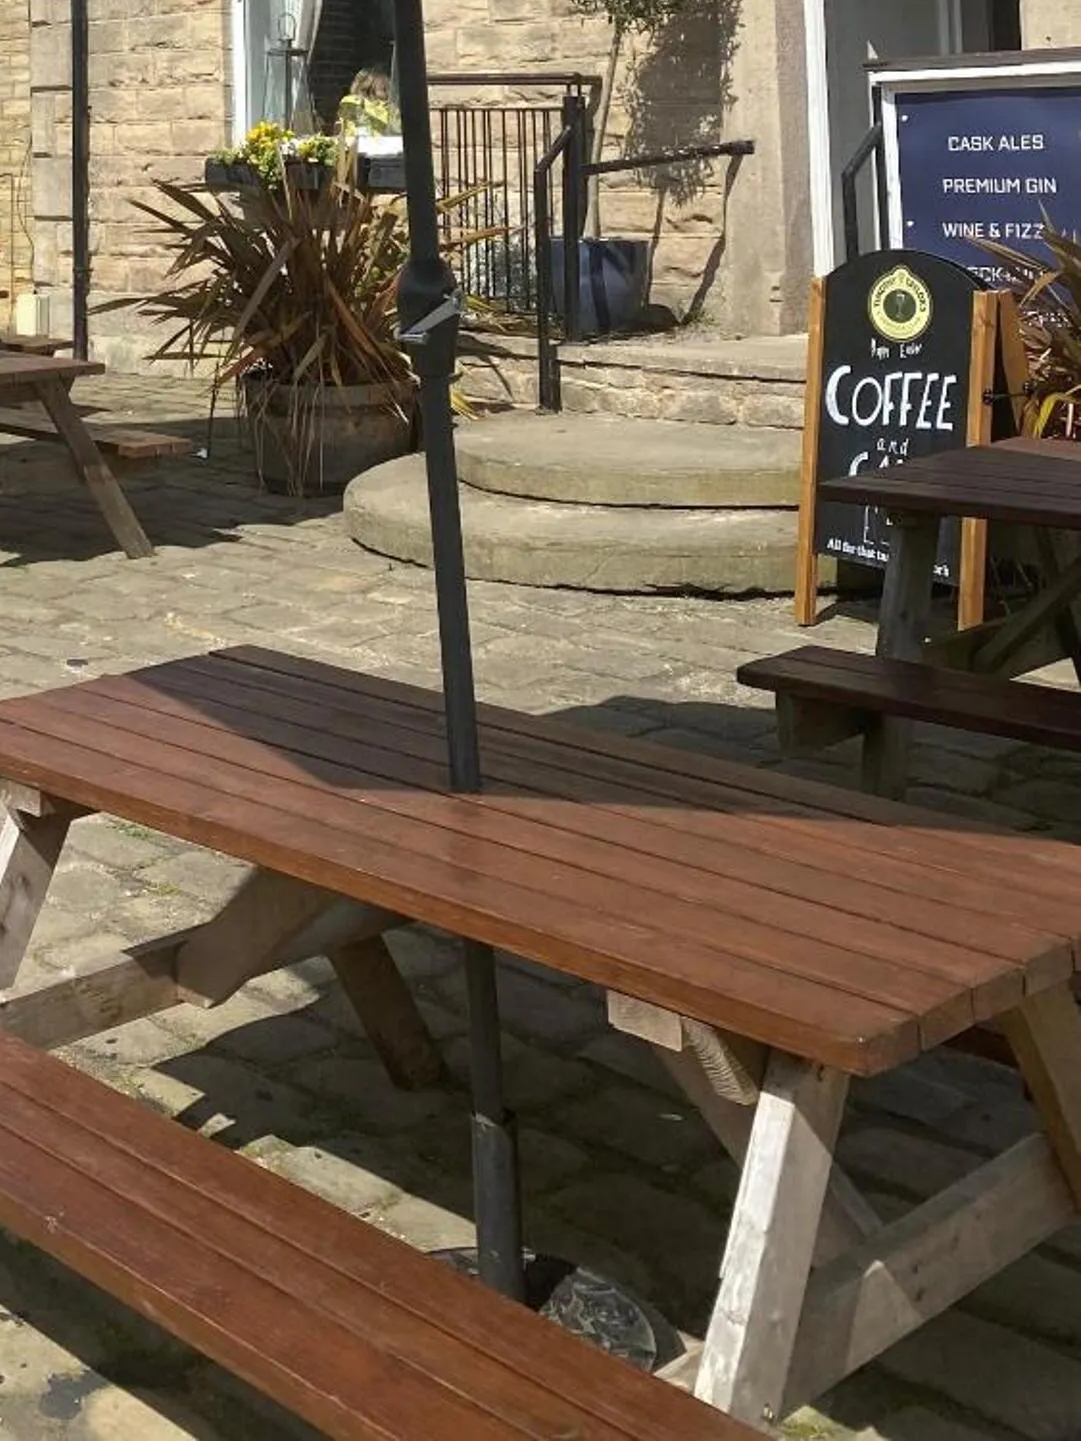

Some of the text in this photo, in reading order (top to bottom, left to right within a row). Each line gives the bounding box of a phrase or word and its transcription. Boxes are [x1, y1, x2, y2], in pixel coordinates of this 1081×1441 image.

[948, 134, 1044, 151] CASK ALES
[942, 177, 1057, 194] PREMIUM GIN
[942, 222, 1046, 240] WINE & FIZZ
[825, 365, 957, 431] COFFEE
[877, 438, 909, 456] and
